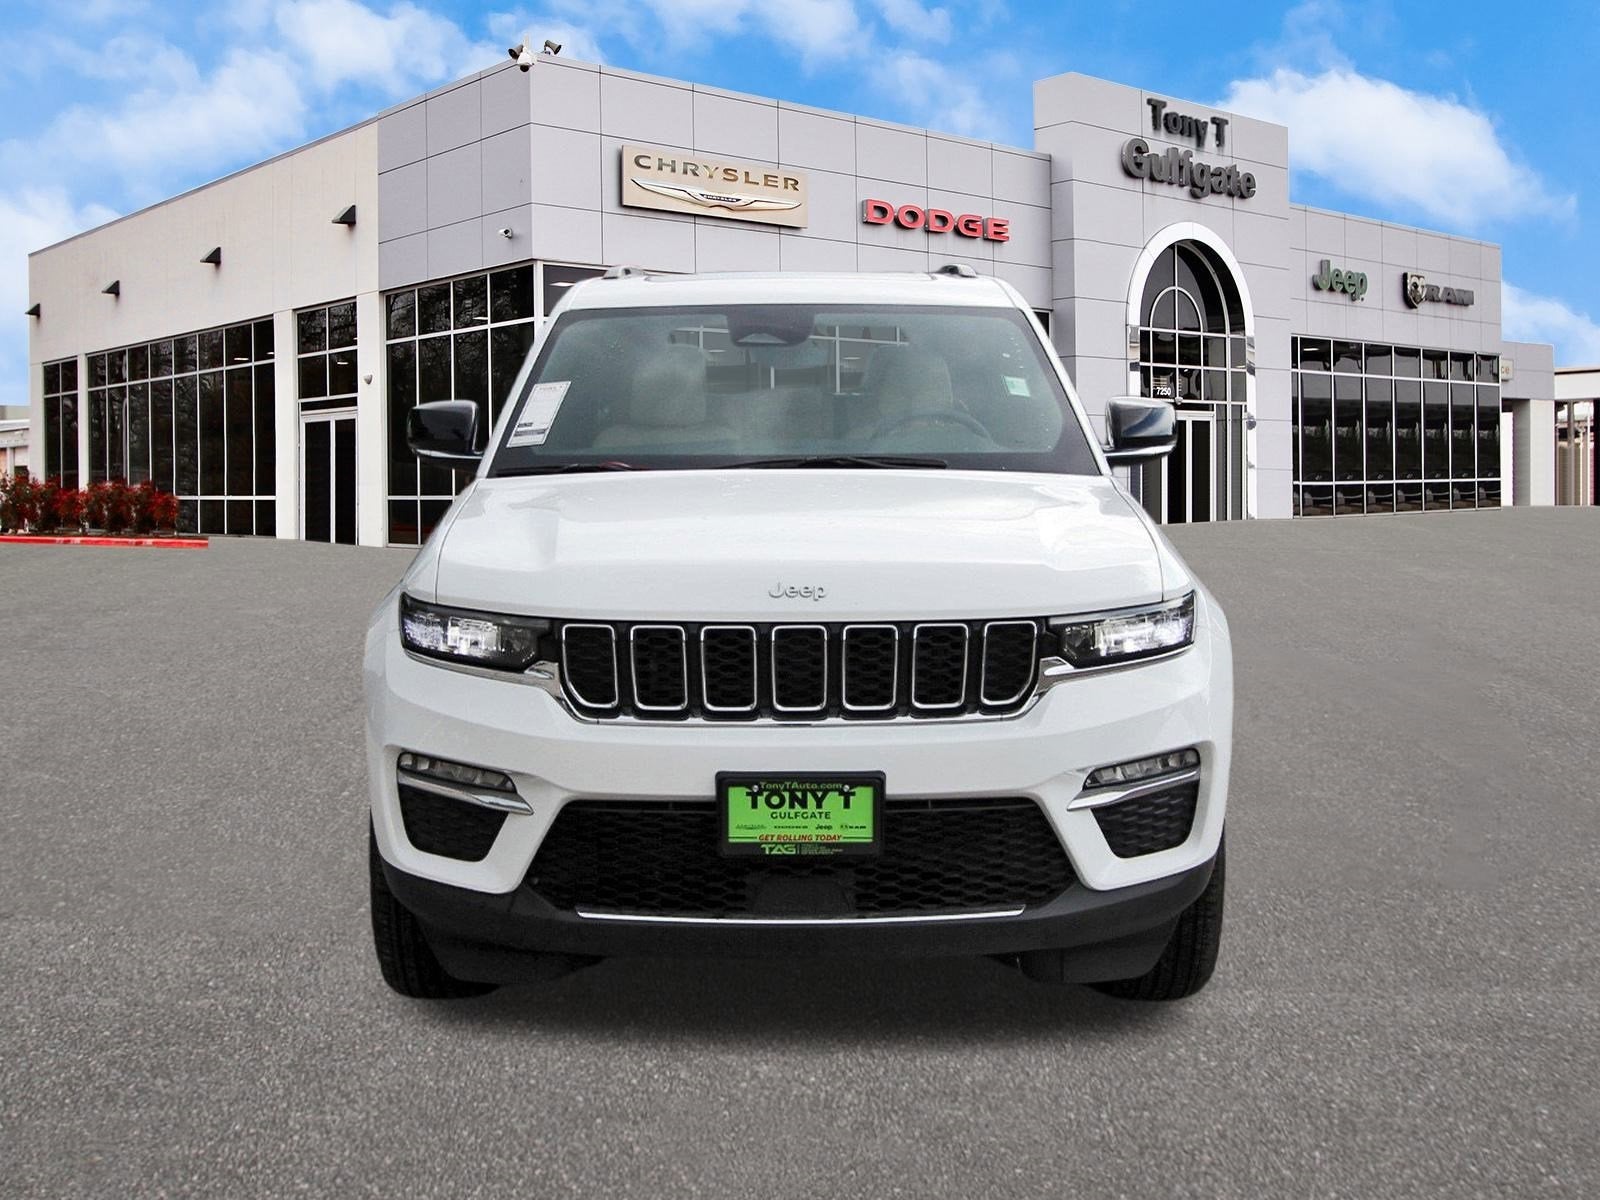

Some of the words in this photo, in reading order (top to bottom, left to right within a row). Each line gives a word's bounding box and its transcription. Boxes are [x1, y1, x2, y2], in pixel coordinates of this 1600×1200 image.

[1146, 98, 1208, 147] Tony
[1210, 116, 1229, 147] T
[633, 154, 800, 192] CHRYSLER
[1121, 137, 1257, 199] Gulfgate
[862, 198, 1010, 242] DODGE
[1312, 259, 1368, 301] Jeep
[1425, 284, 1474, 306] RAM
[768, 580, 828, 601] Jeep
[746, 789, 828, 809] TONY
[838, 790, 856, 809] T
[759, 781, 843, 792] TonyTAuto.com
[770, 811, 831, 820] GULFGATE
